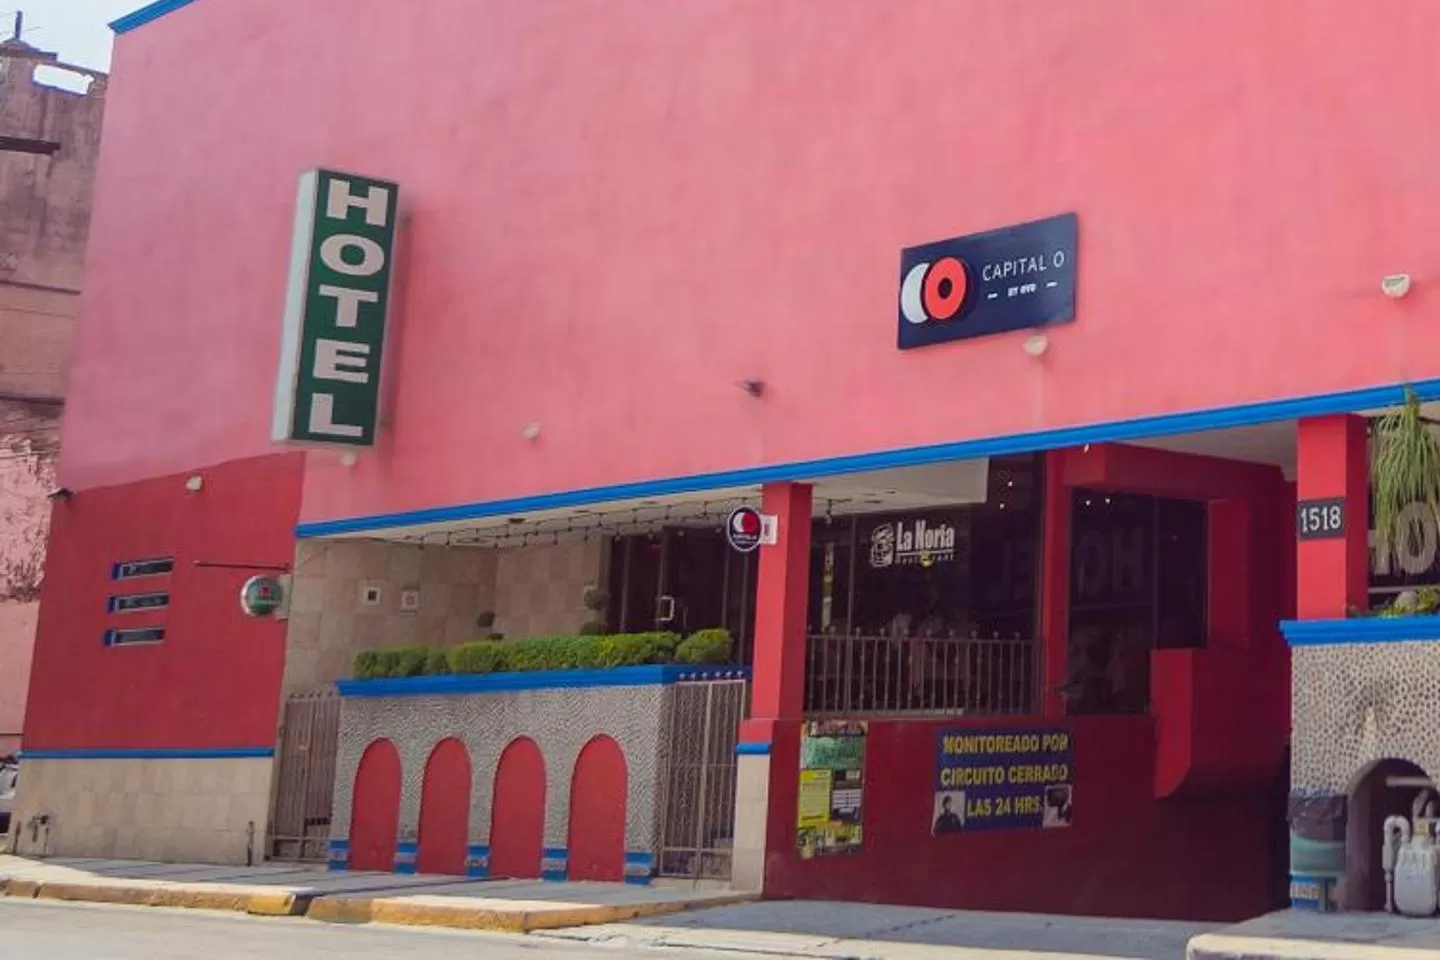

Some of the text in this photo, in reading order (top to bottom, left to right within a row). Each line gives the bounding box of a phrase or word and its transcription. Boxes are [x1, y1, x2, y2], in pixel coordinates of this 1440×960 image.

[982, 251, 1065, 282] CAPITAL O
[308, 178, 388, 437] HOTEL
[1301, 506, 1341, 533] 1518
[897, 519, 955, 551] La Noria
[943, 732, 1069, 754] MONITOREADO POR
[941, 764, 1069, 786] CIRCUITO CERRADO
[967, 798, 992, 817] LAS
[996, 798, 1011, 815] 24
